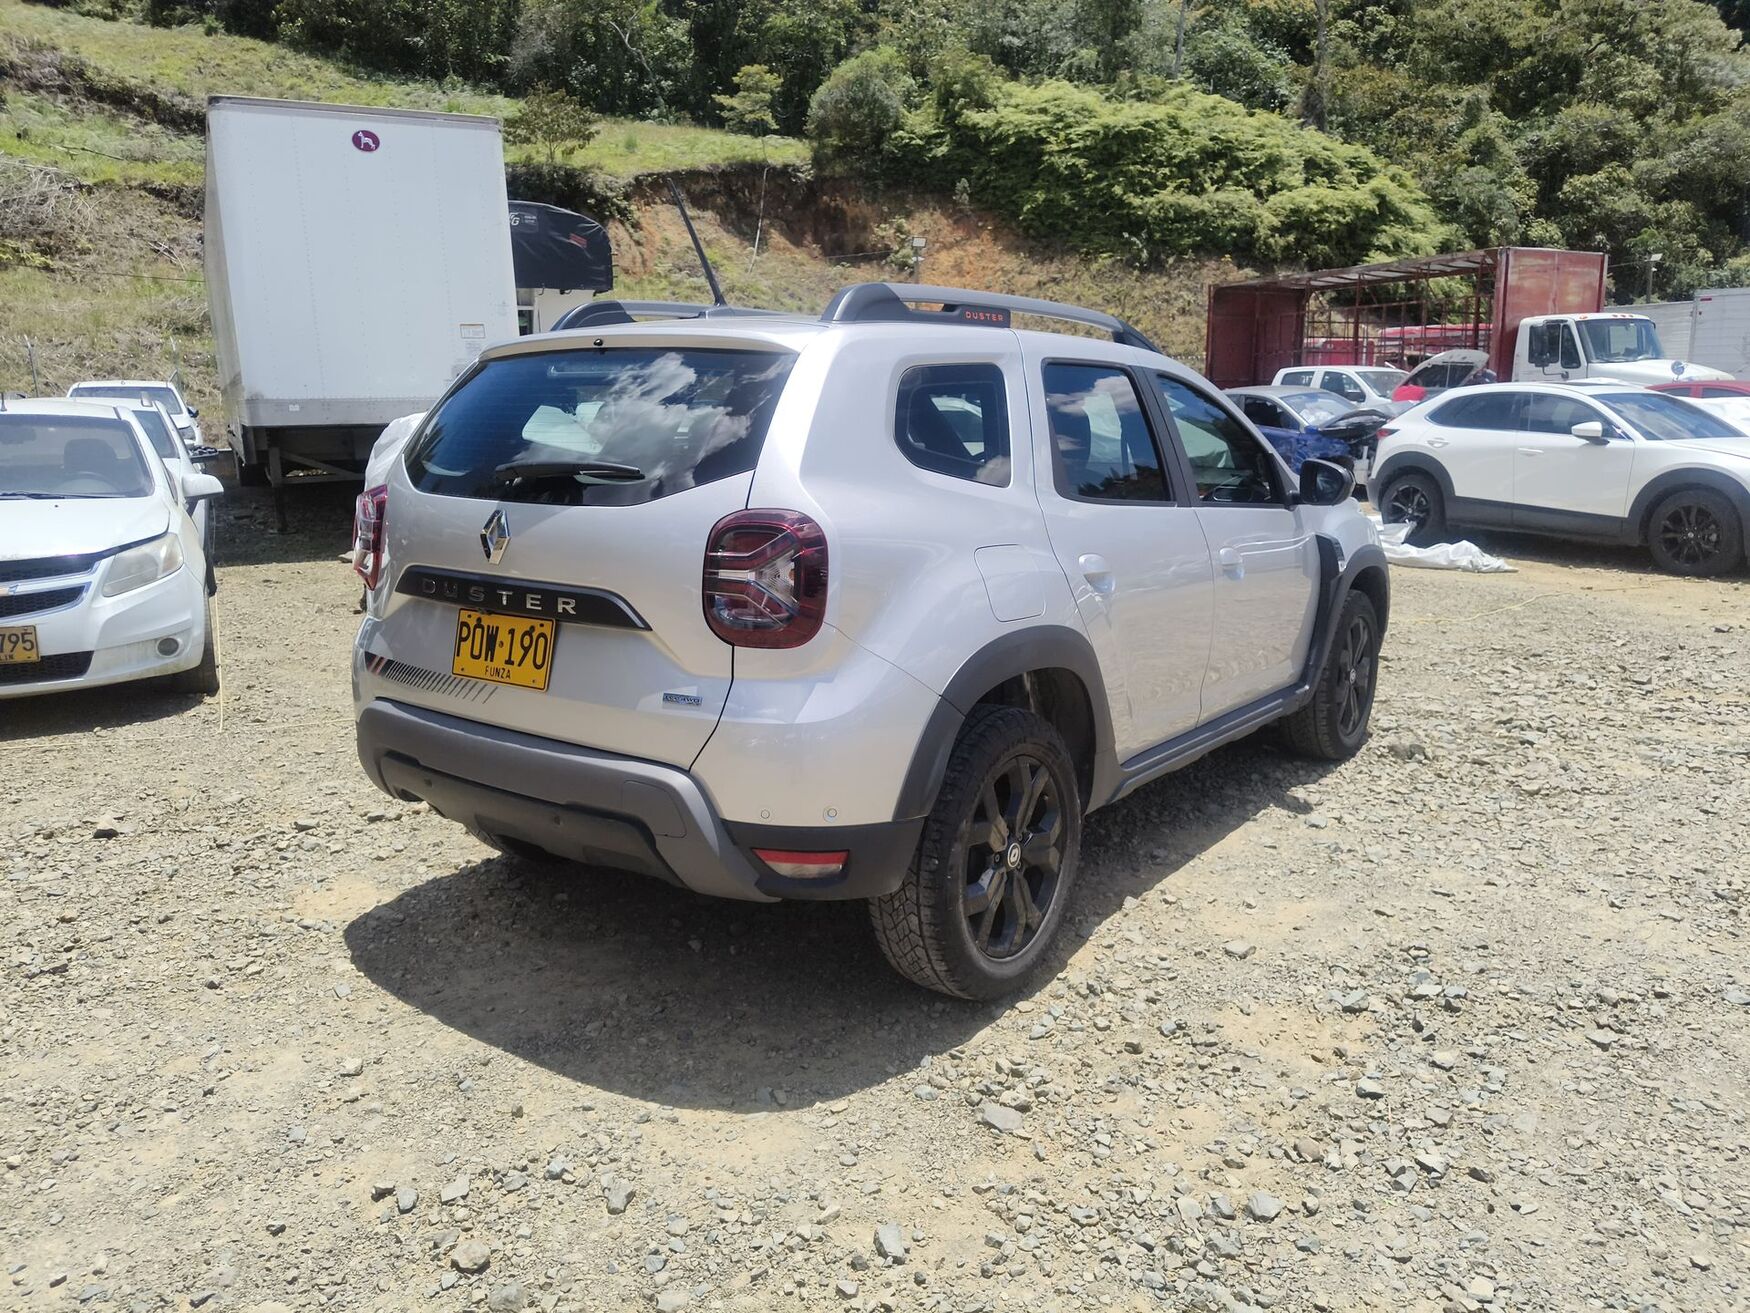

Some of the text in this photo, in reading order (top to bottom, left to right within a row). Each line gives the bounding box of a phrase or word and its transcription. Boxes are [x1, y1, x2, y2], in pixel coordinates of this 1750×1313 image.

[965, 311, 1004, 321] DUSTER
[422, 578, 576, 615] DUSTER
[485, 665, 512, 680] FUNZA
